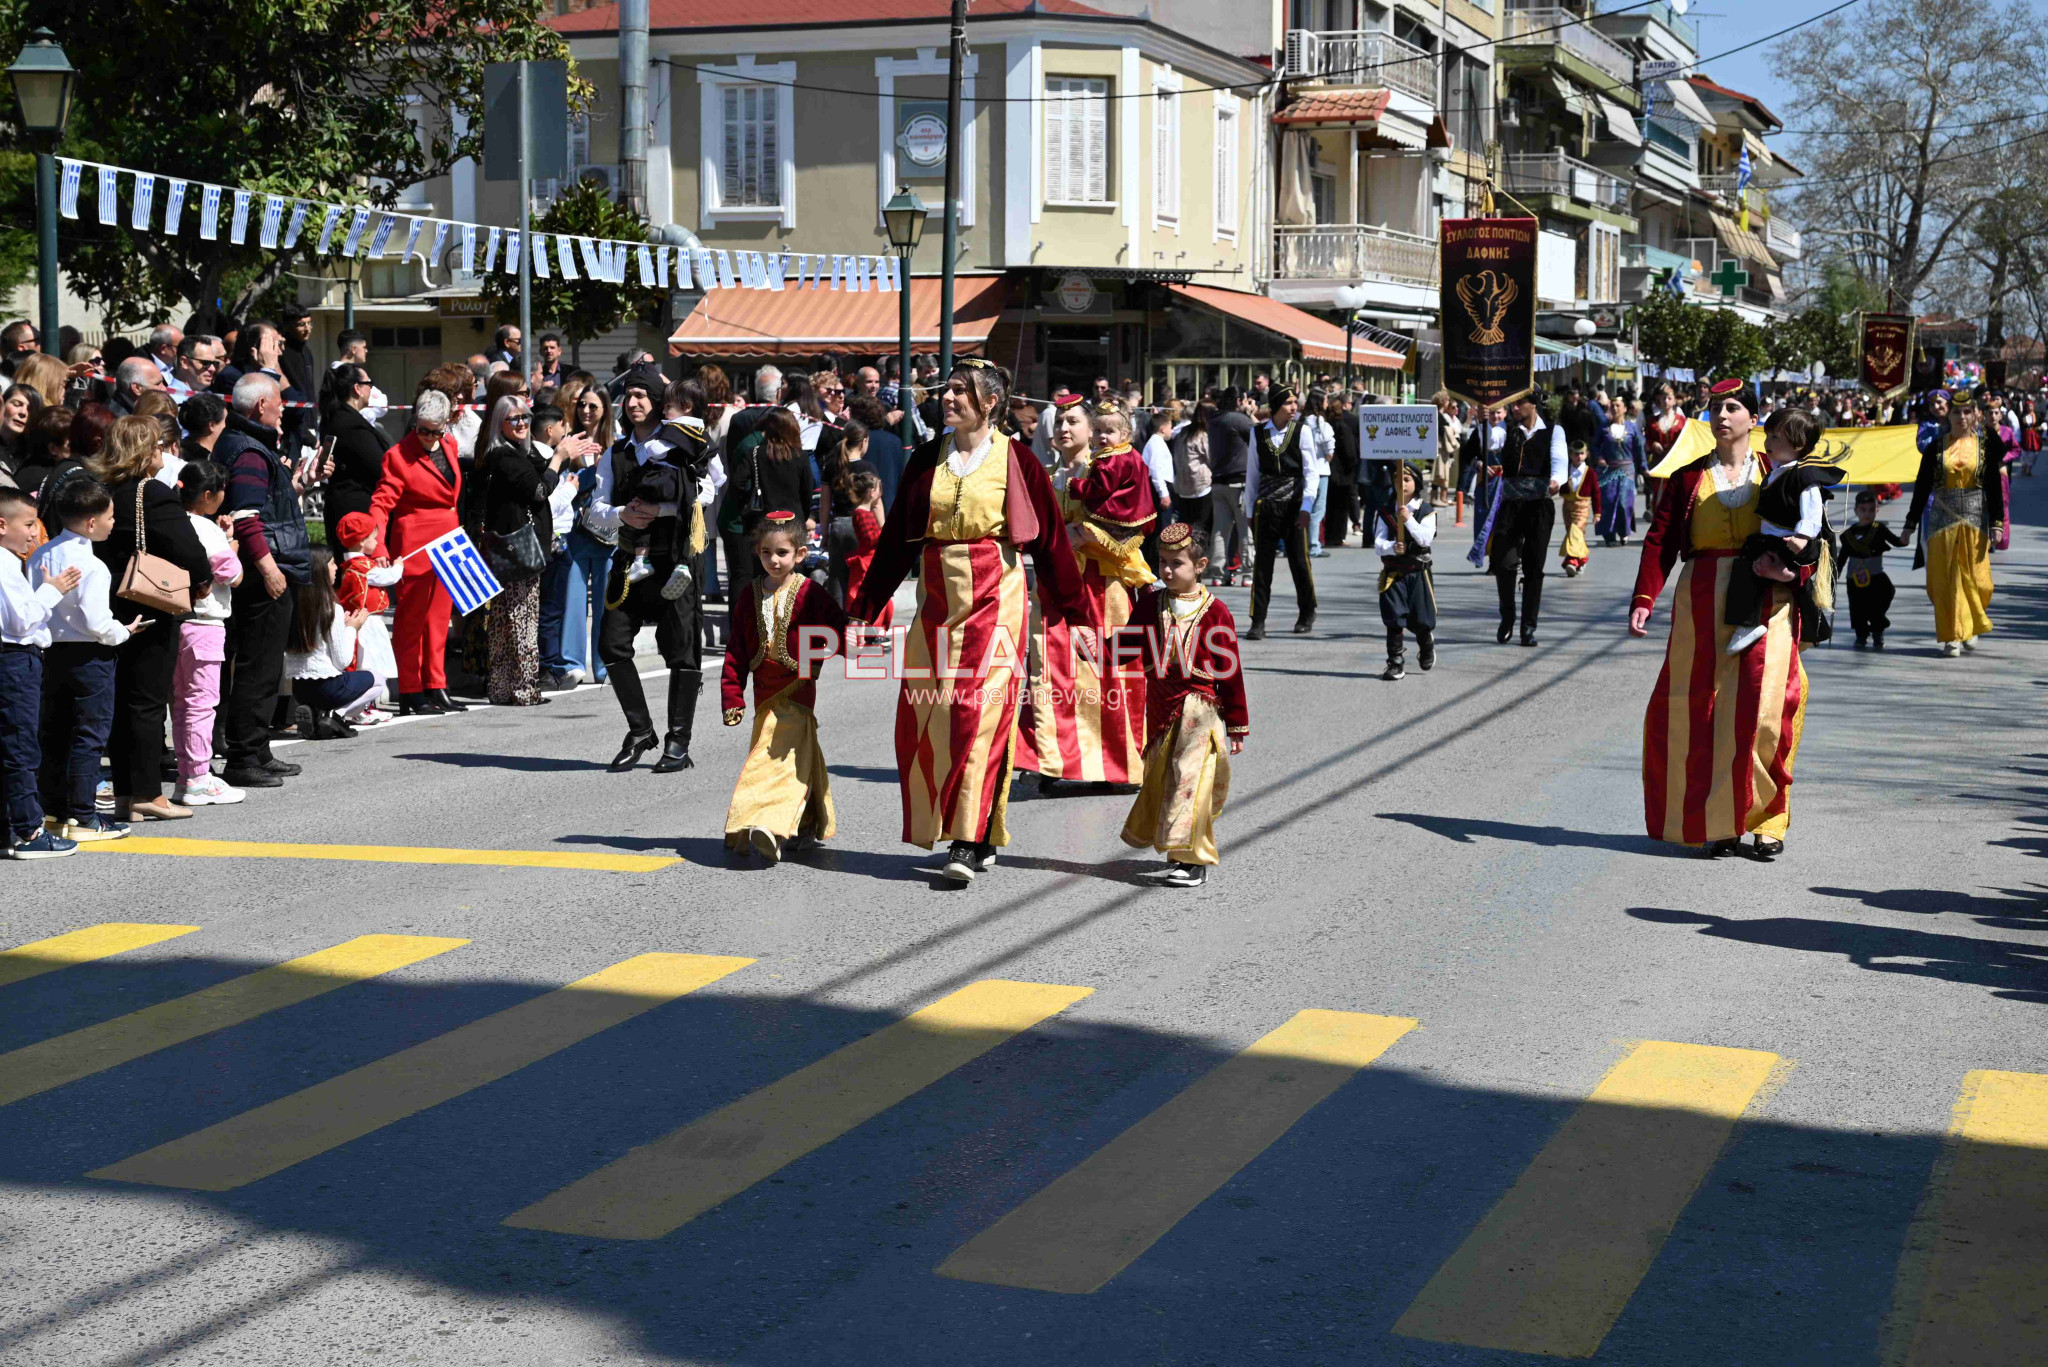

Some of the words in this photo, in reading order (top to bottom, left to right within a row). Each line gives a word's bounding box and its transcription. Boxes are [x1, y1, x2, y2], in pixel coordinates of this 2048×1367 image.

[1645, 61, 1677, 69] ΙΑΤΡΕΙΟ
[1446, 227, 1490, 244] ΣΥΛΛΟΓΟΣ
[1492, 227, 1531, 243] ΠΟΝΤΙΩΝ
[1466, 246, 1510, 259] ΔΑΦΝΗΣ
[1363, 413, 1400, 423] ΠΟΝΤΙΑΚΟΣ
[1400, 413, 1433, 423] ΣΥΛΛΟΓΟΣ
[1384, 426, 1412, 437] ΔΑΦΝΗΣ
